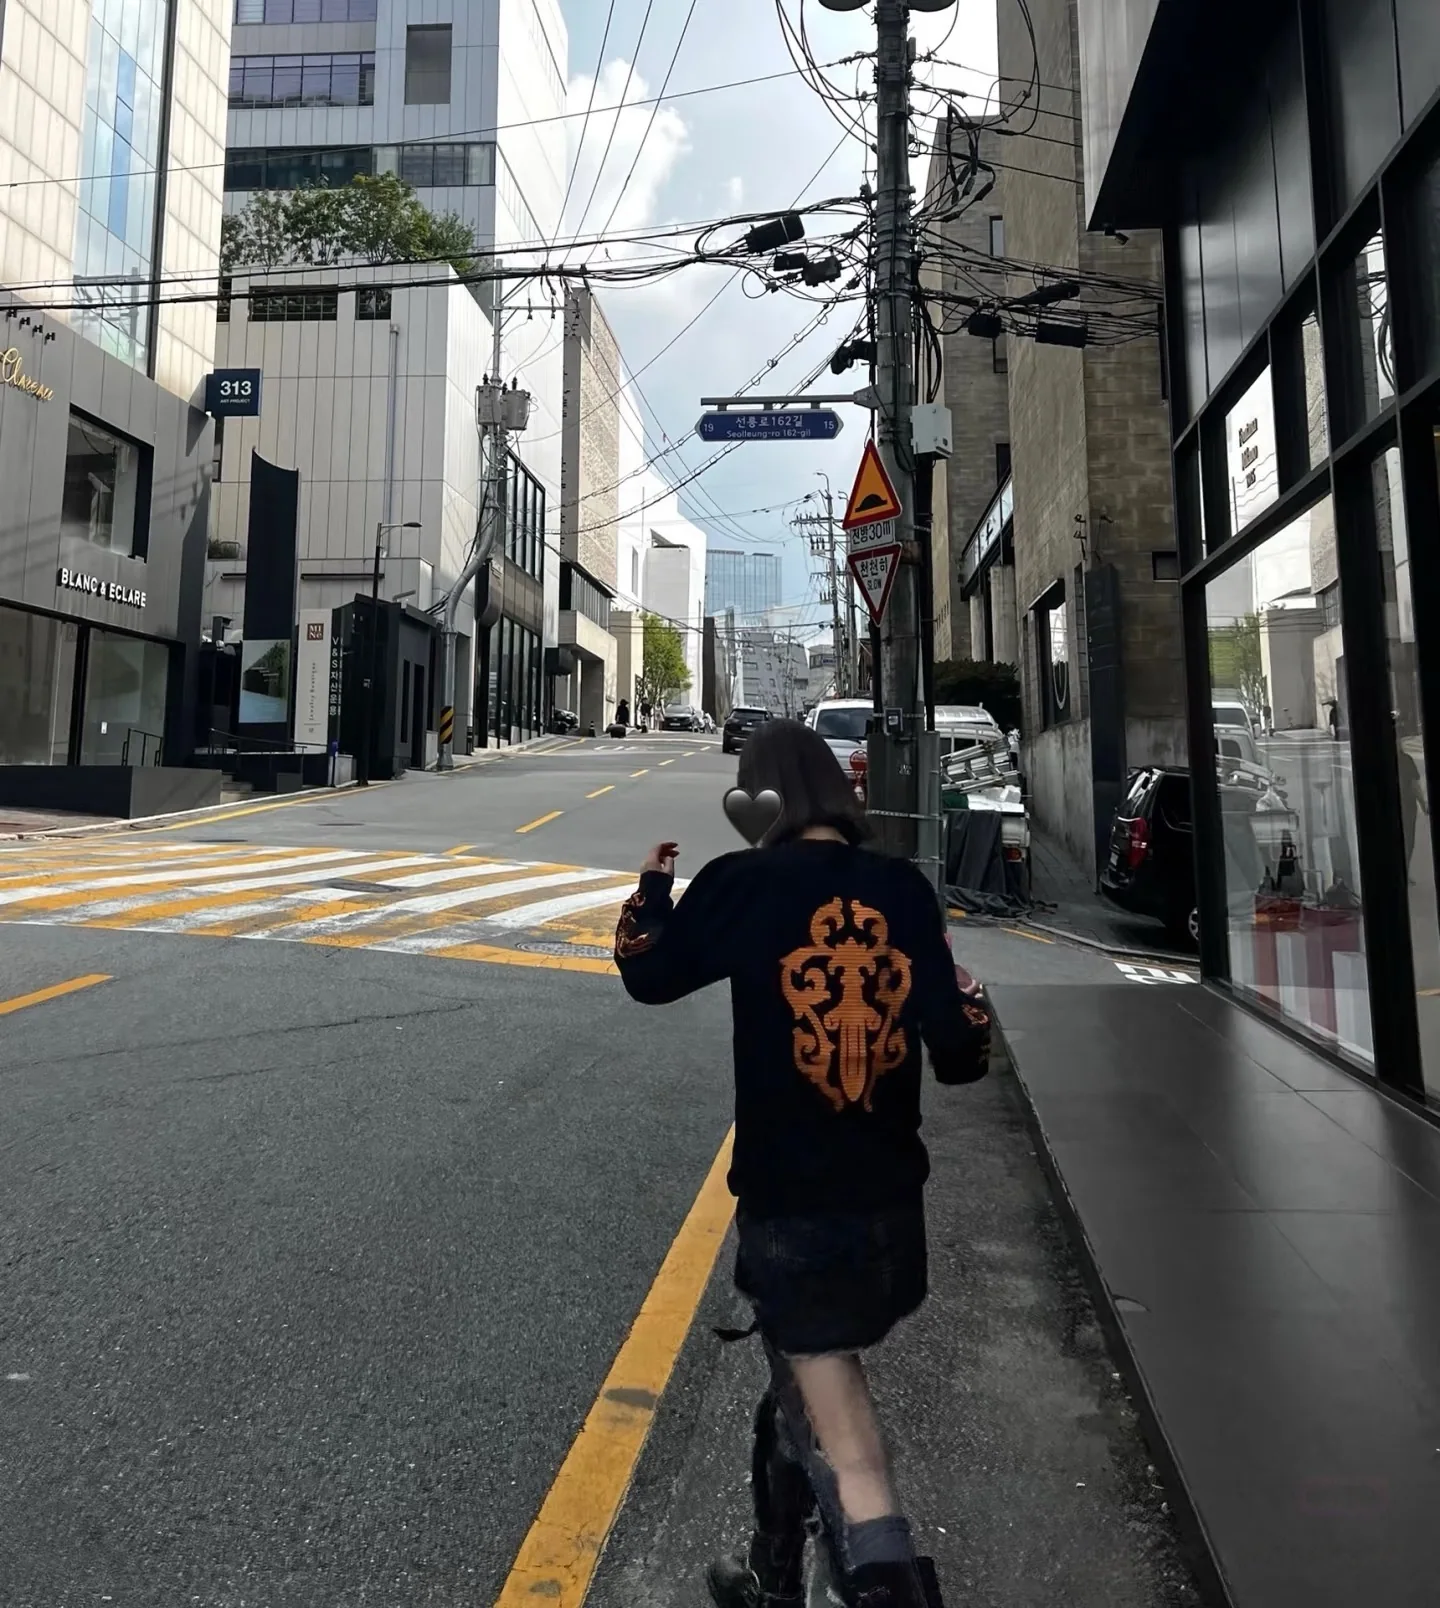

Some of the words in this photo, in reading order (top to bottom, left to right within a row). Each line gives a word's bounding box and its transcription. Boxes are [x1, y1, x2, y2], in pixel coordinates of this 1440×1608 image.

[220, 380, 252, 396] 313
[704, 423, 714, 432] 19
[824, 420, 834, 430] 15
[726, 430, 780, 439] Seolleung-ro
[783, 428, 811, 438] 162-gil
[860, 556, 888, 578] 천천히
[61, 567, 98, 593] BLANC
[100, 581, 106, 595] &
[109, 582, 147, 608] ECLARE
[867, 578, 882, 591] SLOW
